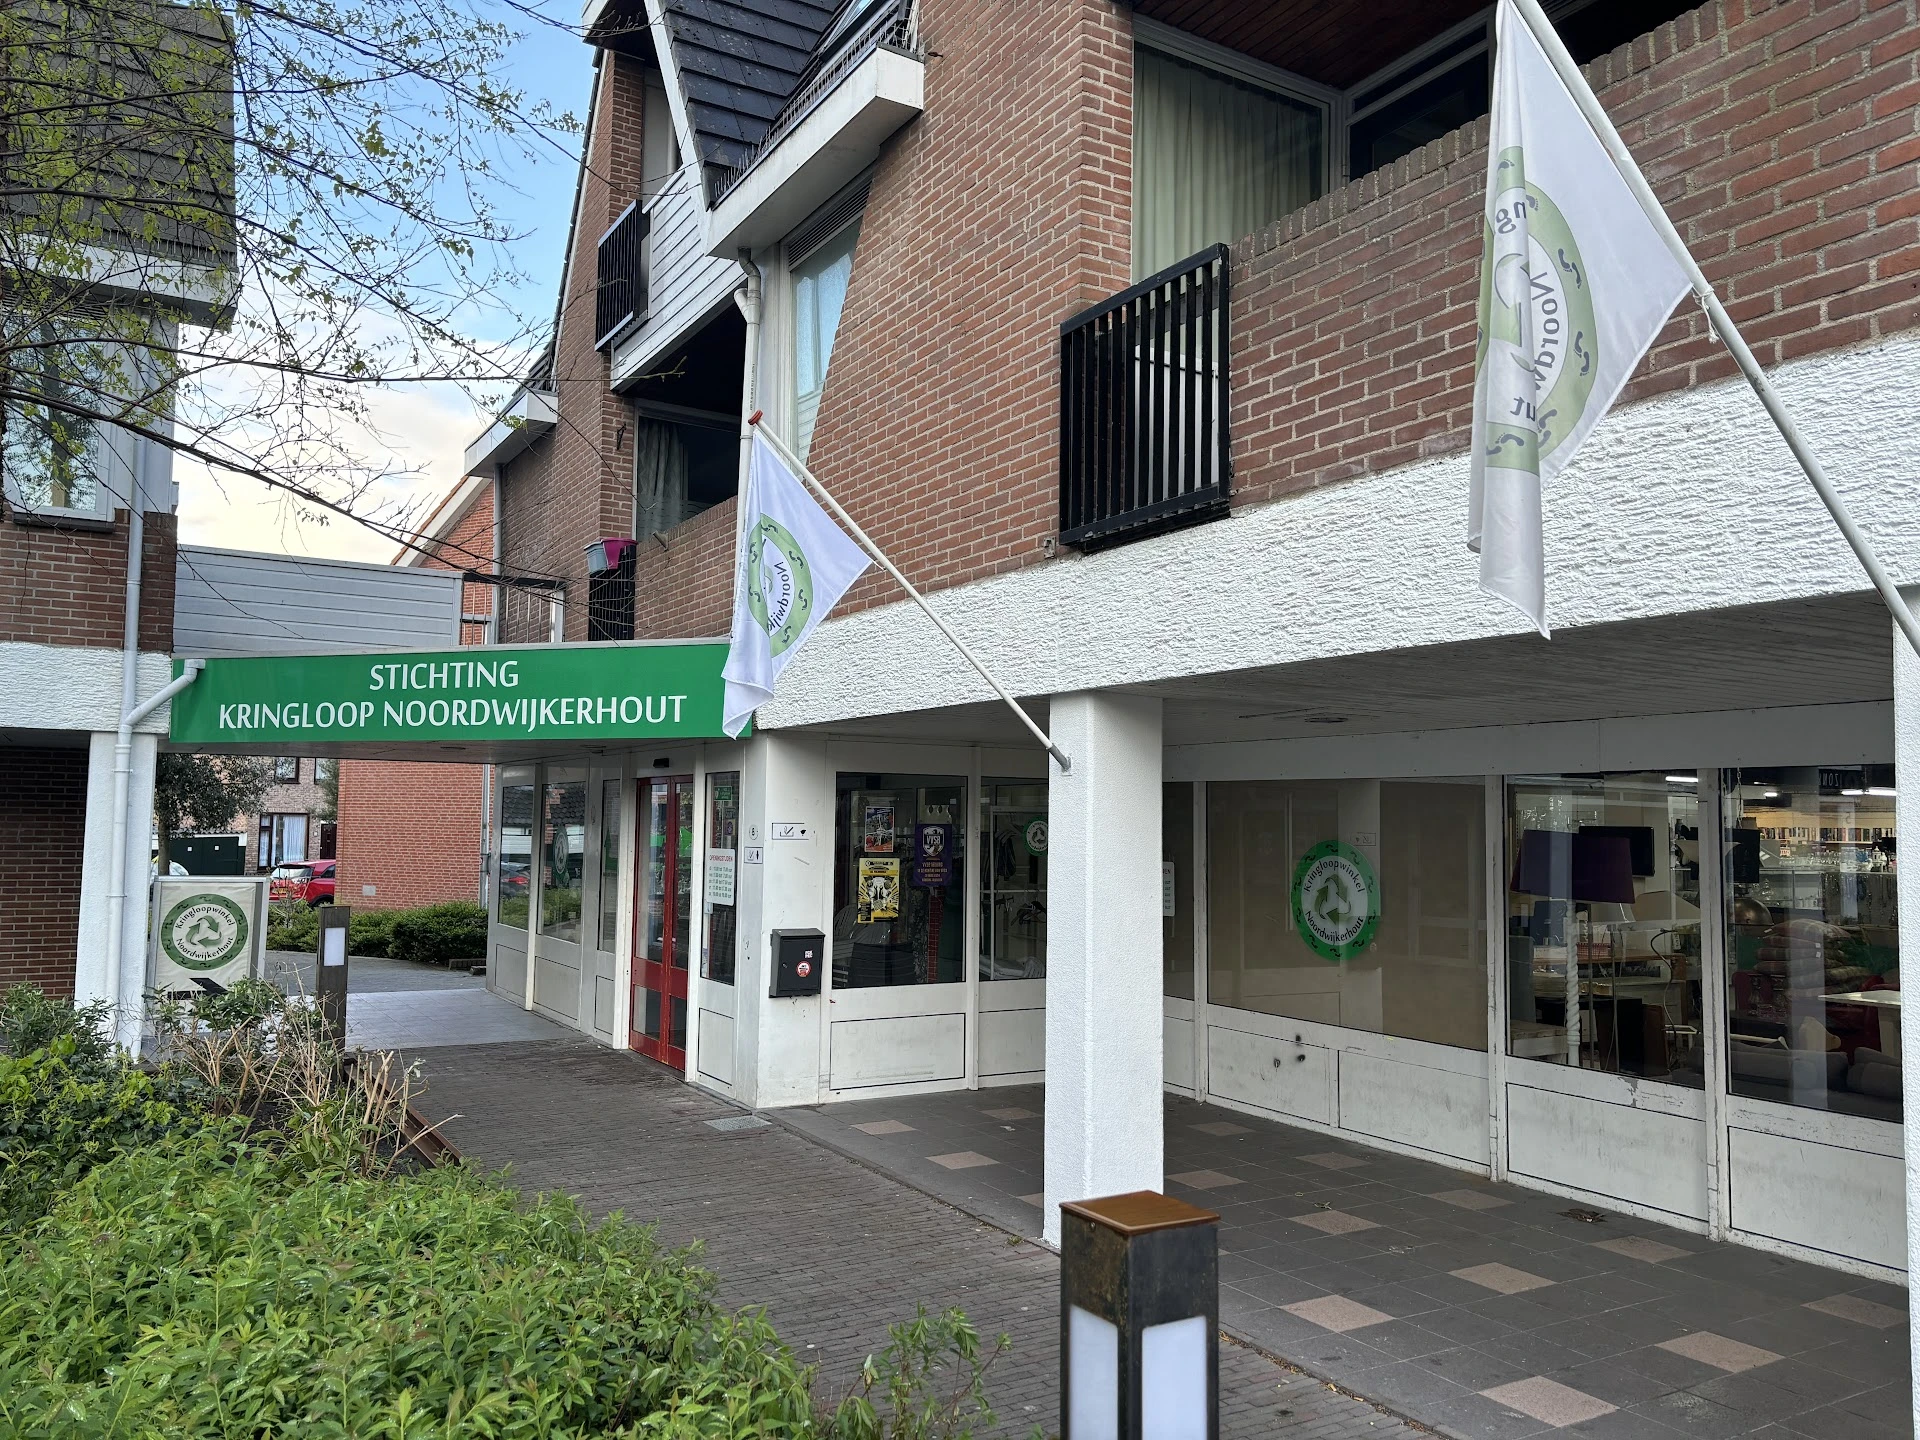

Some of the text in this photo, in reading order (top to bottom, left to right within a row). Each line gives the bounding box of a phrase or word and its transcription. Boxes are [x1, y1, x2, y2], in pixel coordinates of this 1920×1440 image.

[369, 660, 519, 691] STICHTING
[219, 695, 688, 733] KRINGLOOP NOORDWIJKERHOUT
[926, 835, 941, 845] VVSB
[1303, 860, 1367, 893] Kringloopwinkel
[175, 906, 236, 930] Kringloopwinkel
[1305, 910, 1365, 945] Noordwijkerhout
[175, 936, 235, 962] Noordwijkerhout
